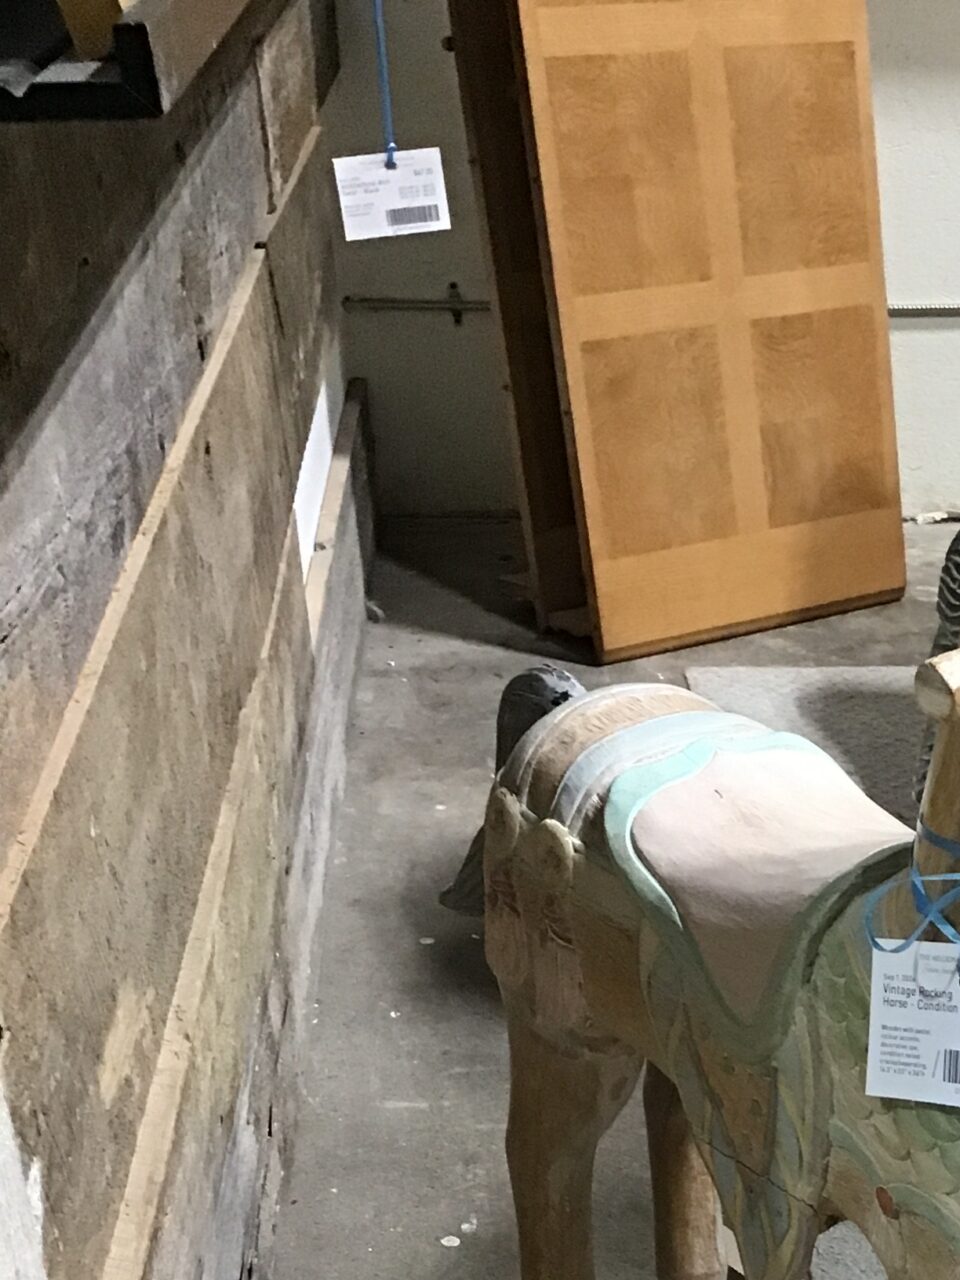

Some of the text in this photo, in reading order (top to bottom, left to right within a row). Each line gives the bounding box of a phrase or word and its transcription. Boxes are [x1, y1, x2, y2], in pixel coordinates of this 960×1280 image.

[883, 983, 952, 1001] Vintage Rocking
[883, 997, 908, 1009] Horse
[917, 999, 958, 1014] Condition
